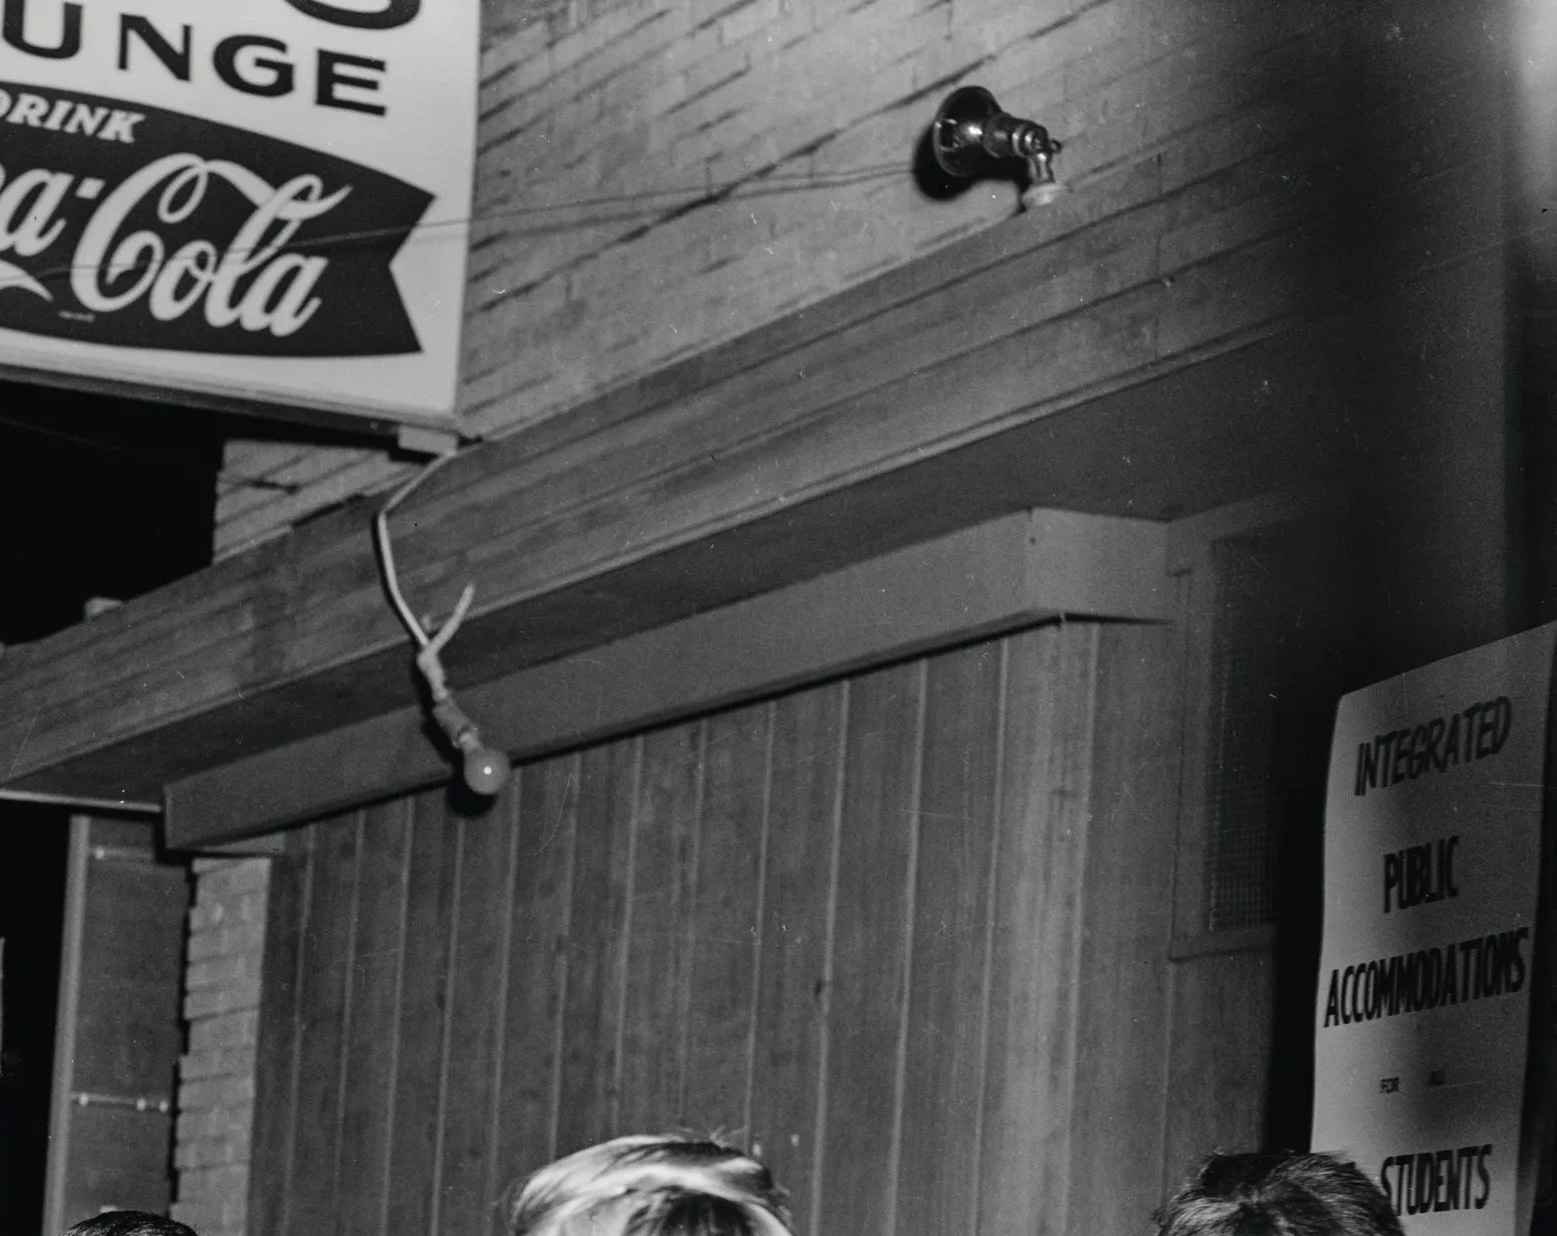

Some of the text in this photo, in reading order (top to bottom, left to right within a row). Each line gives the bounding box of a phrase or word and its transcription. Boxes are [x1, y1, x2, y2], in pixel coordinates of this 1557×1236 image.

[1353, 696, 1514, 797] INTEGRATED
[1382, 835, 1460, 914] PUBLIC
[1322, 926, 1531, 1029] ACCOMMODATIONS
[1380, 1144, 1493, 1217] STUDENTS
